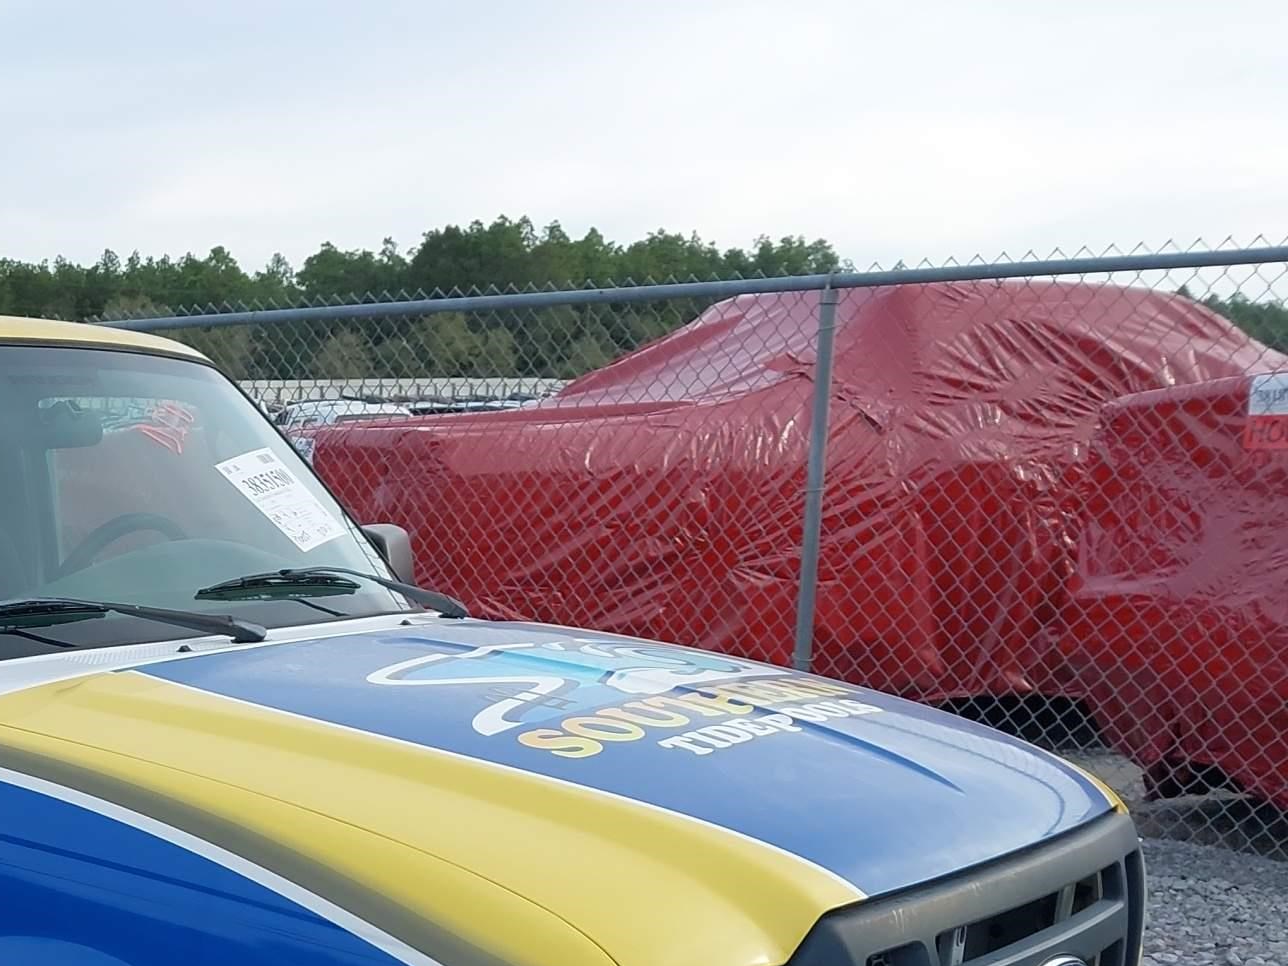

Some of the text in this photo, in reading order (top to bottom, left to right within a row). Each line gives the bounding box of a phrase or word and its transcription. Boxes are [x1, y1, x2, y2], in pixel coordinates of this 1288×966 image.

[517, 678, 854, 758] SOUTHERN
[657, 699, 883, 755] TIDE POOLS
